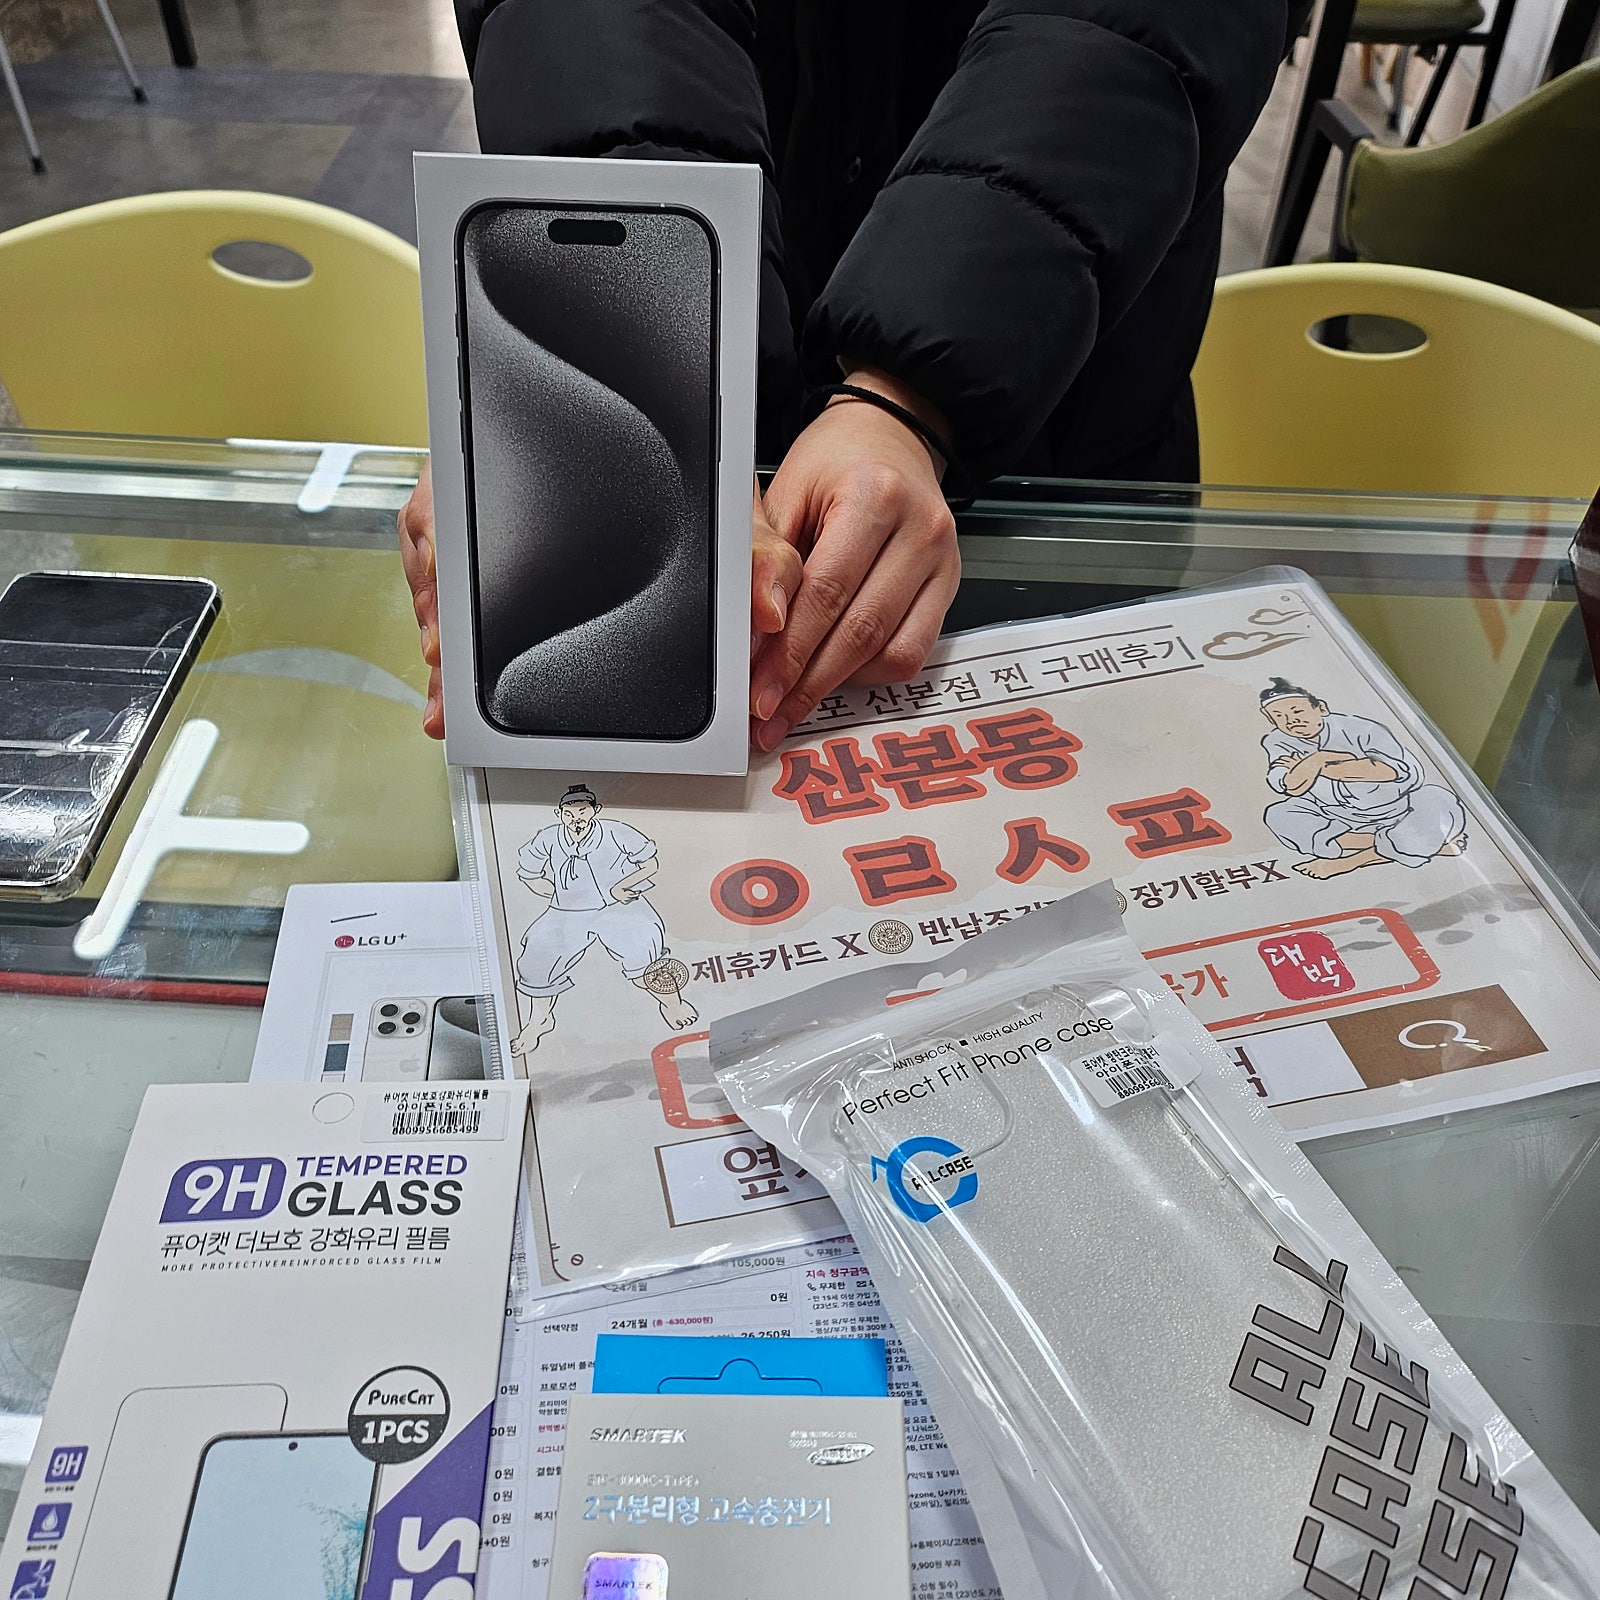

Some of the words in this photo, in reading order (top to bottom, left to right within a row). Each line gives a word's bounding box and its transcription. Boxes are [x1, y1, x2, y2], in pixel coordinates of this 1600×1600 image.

[865, 671, 982, 716] 산본점
[992, 667, 1035, 693] 찐
[1041, 635, 1197, 681] 구매후기
[772, 707, 1084, 824] 산본동
[358, 935, 380, 947] LG
[384, 932, 408, 946] U+
[691, 937, 829, 984] 제휴카드
[836, 932, 869, 959] X
[892, 1057, 914, 1072] ANTI
[914, 1042, 955, 1063] SHOCK
[972, 1028, 1002, 1045] HIGH
[1002, 1011, 1044, 1035] QUALITY
[841, 1075, 936, 1125] Perfect
[971, 1036, 1053, 1074] Phone
[1057, 1016, 1115, 1043] case
[296, 1155, 468, 1177] TEMPERED
[184, 1164, 273, 1215] 9H
[287, 1180, 463, 1217] GLASS
[161, 1230, 231, 1258] 퓨어캣
[235, 1229, 303, 1254] 더보호
[309, 1226, 399, 1252] 강화유리
[406, 1226, 451, 1252] 필름
[161, 1264, 195, 1272] MORE
[367, 1256, 406, 1266] GLASS
[413, 1256, 443, 1265] FILM
[770, 1293, 788, 1302] 0원
[611, 1318, 649, 1330] 24개월
[500, 1384, 519, 1396] 0원
[540, 1381, 577, 1391] 프로모션
[361, 1420, 430, 1445] 1PCS
[590, 1428, 688, 1444] SMARTEK
[51, 1452, 83, 1477] 9H
[494, 1468, 514, 1480] 0원
[493, 1490, 513, 1502] 0원
[492, 1512, 512, 1525] 0원
[582, 1494, 700, 1526] 2구분리형
[706, 1496, 832, 1527] 고속충전기
